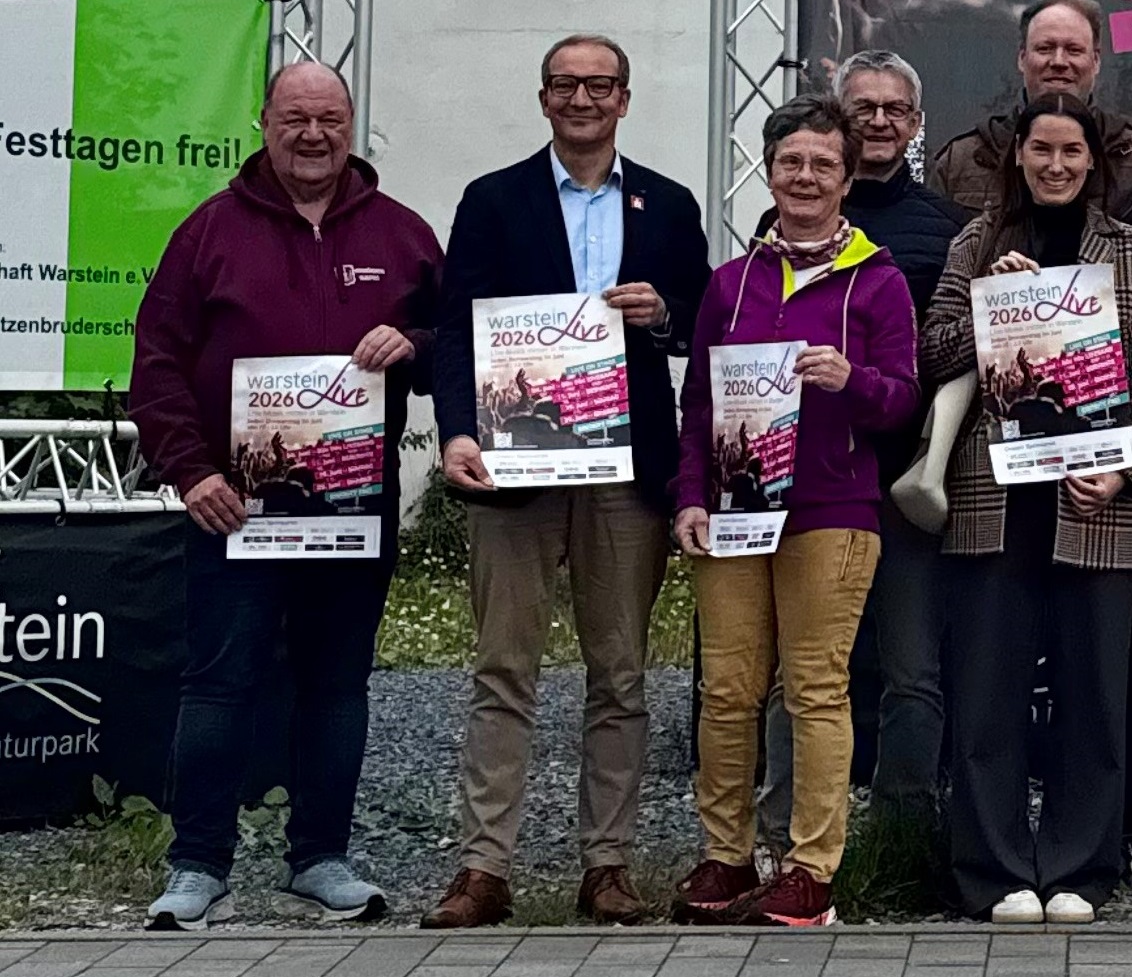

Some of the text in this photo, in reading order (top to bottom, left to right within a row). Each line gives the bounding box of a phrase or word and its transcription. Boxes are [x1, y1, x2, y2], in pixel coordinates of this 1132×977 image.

[0, 121, 241, 171] esttagen frei!
[38, 263, 120, 284] Warstein
[984, 284, 1062, 308] warstein
[1, 315, 135, 336] tzenbrudersch
[487, 310, 568, 330] warstein
[988, 307, 1032, 326] 2026
[490, 330, 536, 347] 2026
[247, 371, 328, 389] warstein
[723, 379, 755, 397] 2026
[249, 391, 294, 408] 2026
[0, 726, 100, 763] turpark
